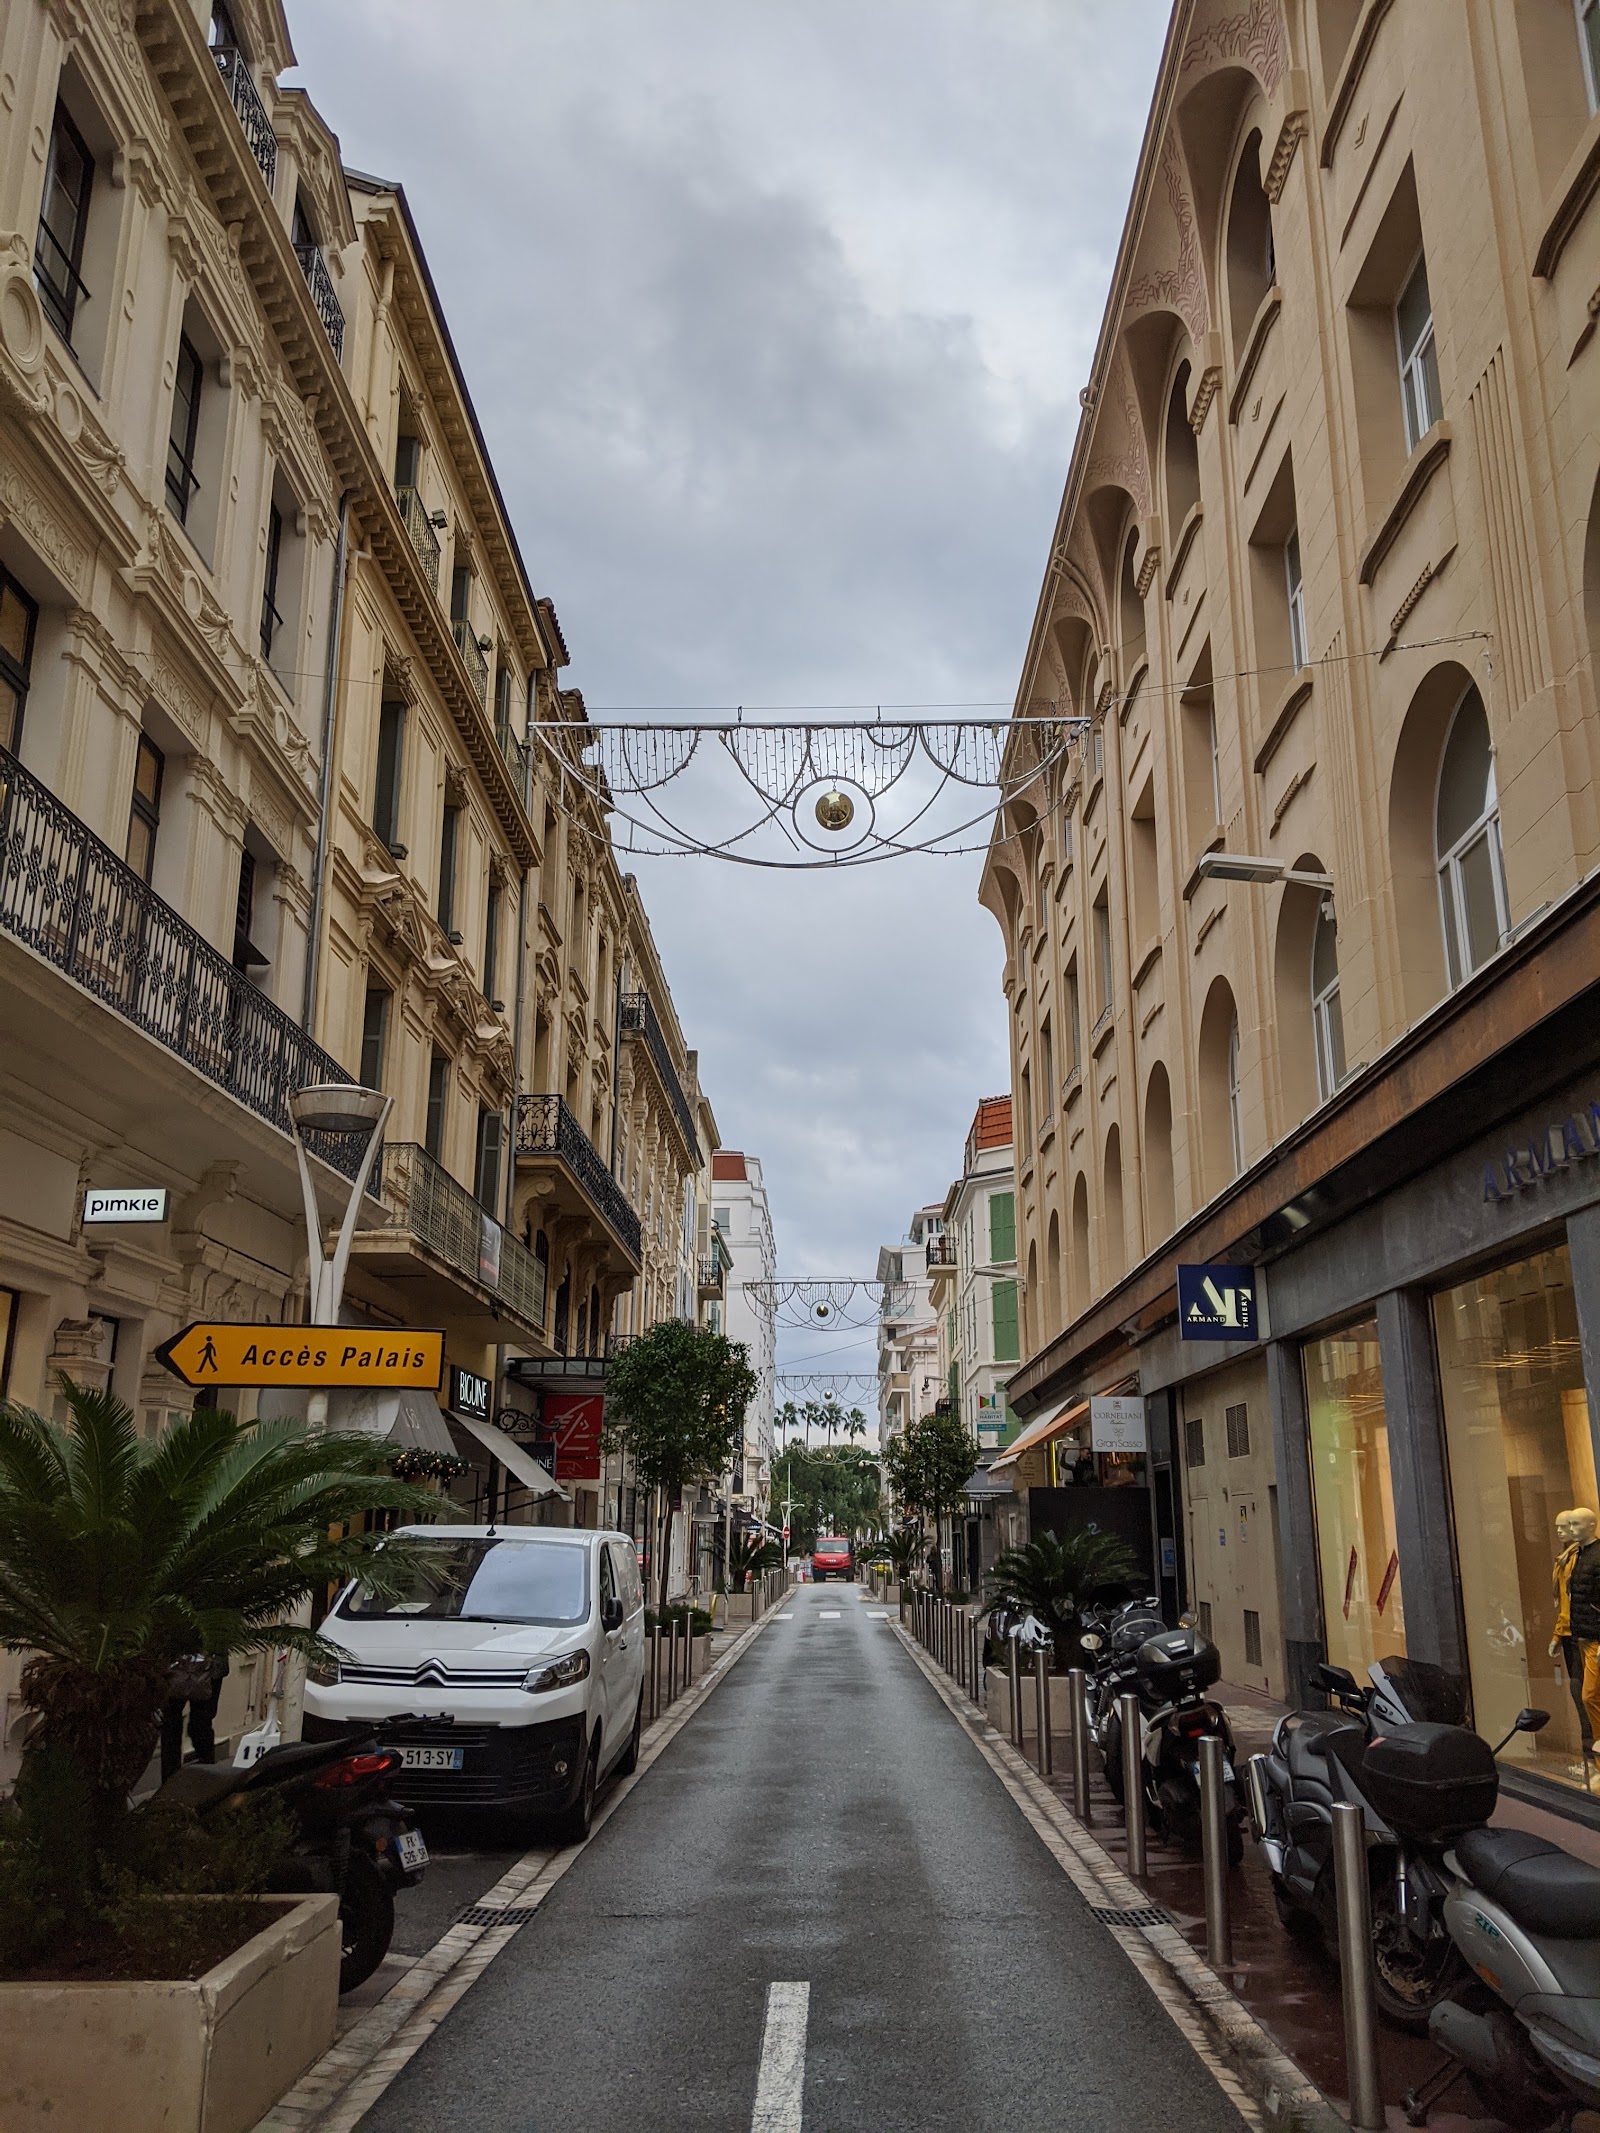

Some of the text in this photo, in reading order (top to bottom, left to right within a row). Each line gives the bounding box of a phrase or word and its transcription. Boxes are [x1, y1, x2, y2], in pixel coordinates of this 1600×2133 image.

[91, 1199, 159, 1215] pimkie
[1241, 1296, 1249, 1328] THIERY
[241, 1345, 425, 1368] Accès Palais
[460, 1371, 487, 1409] BIGUINE
[1093, 1412, 1142, 1420] CORNELIANI
[1475, 1912, 1500, 1937] ZIP
